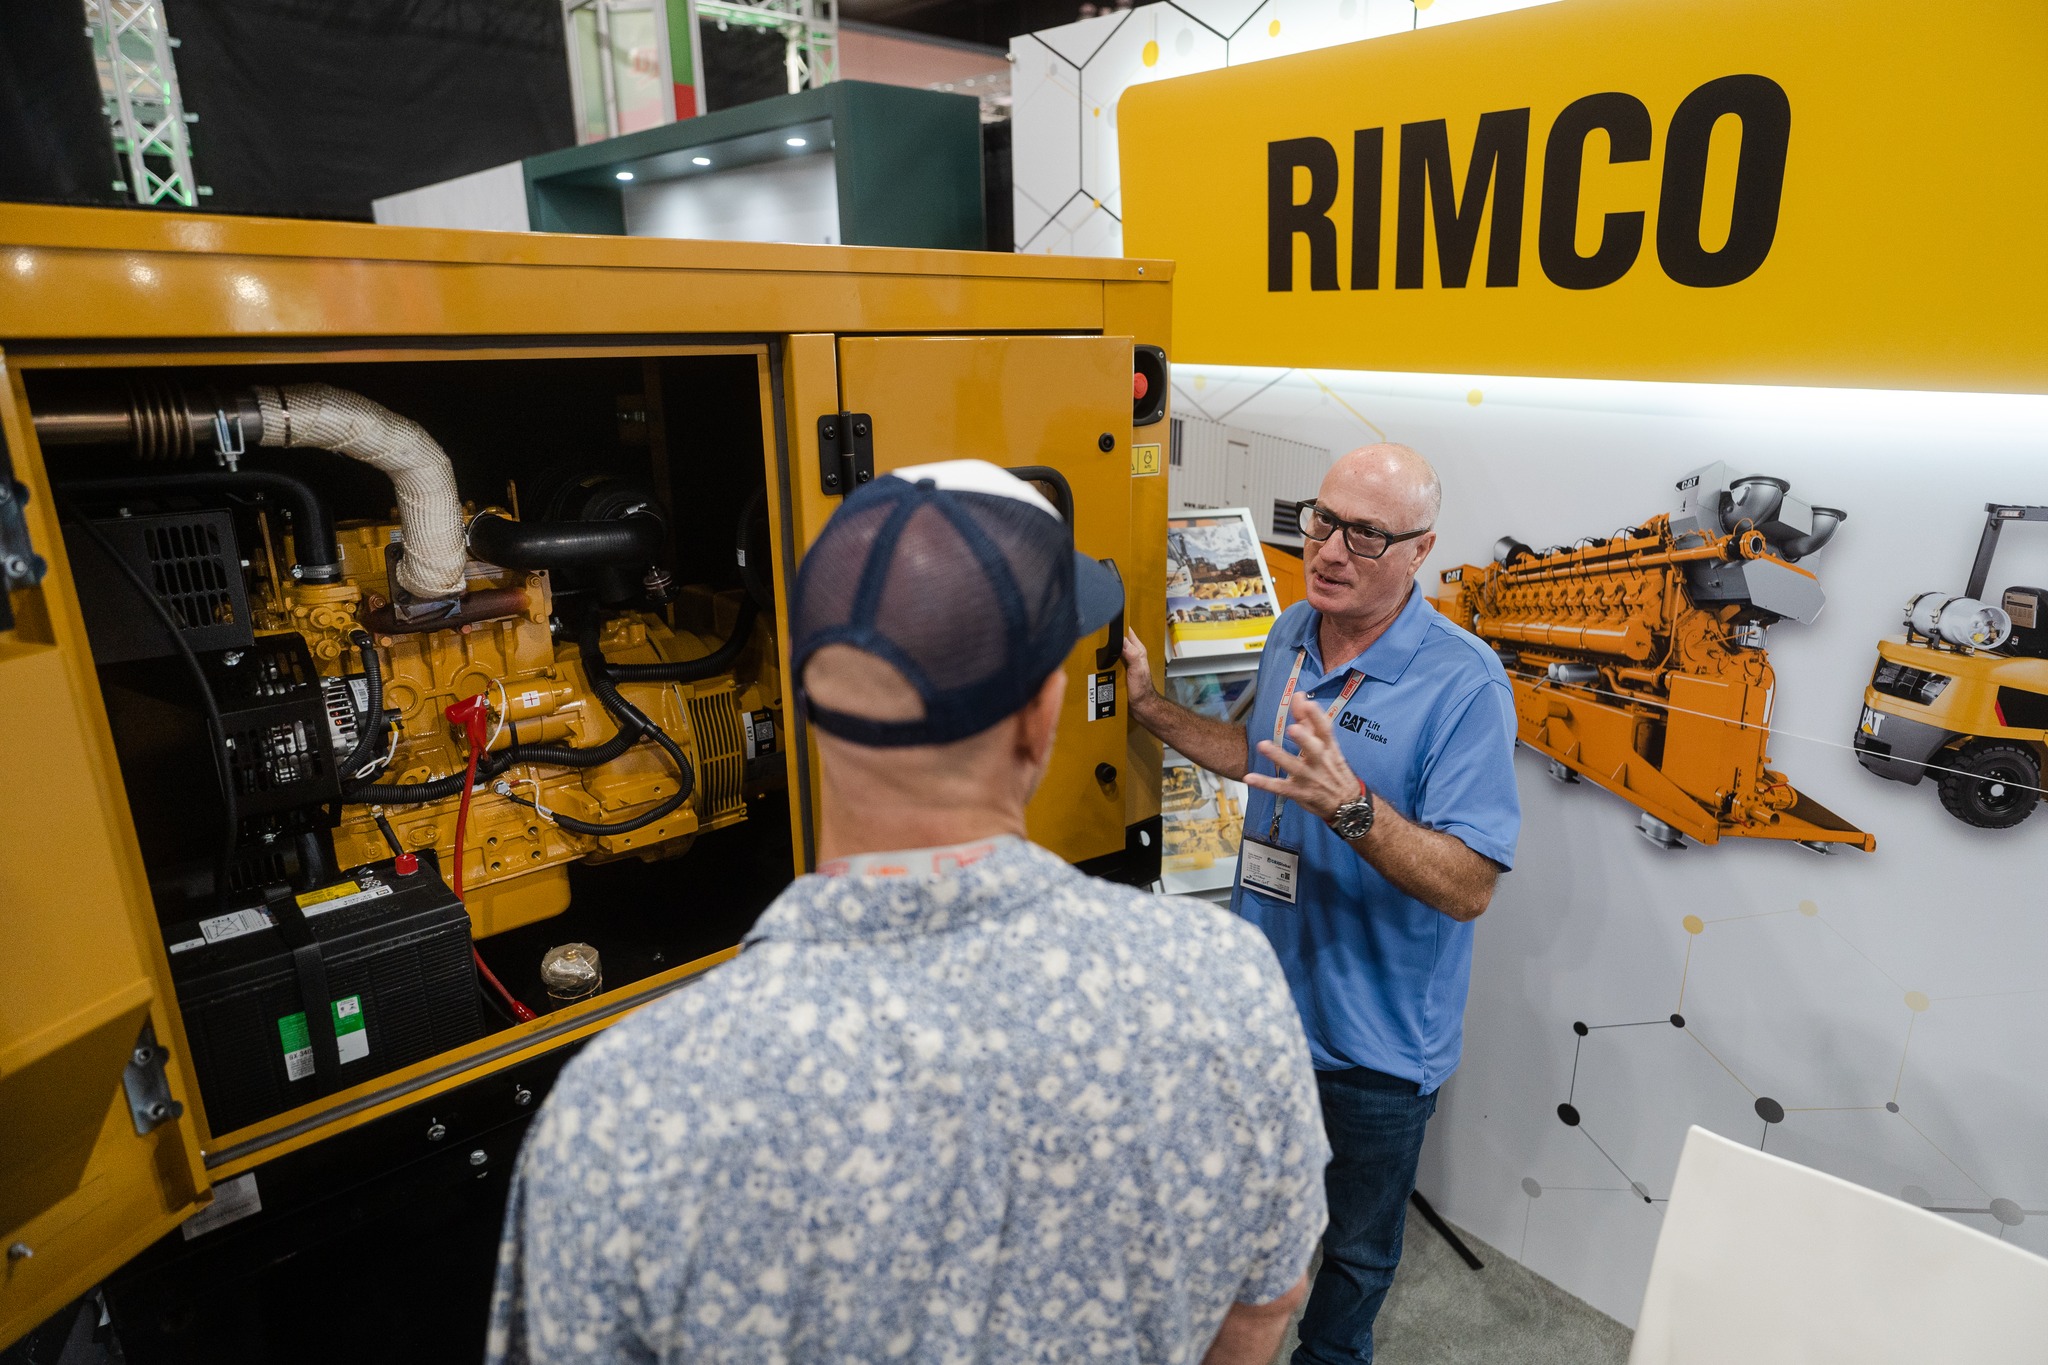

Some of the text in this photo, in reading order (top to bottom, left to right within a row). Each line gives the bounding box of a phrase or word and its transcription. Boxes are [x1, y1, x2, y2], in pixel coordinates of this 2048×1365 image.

[1267, 73, 1792, 293] RIMCO
[1682, 477, 1698, 490] CAT
[1446, 569, 1462, 583] CAT
[1339, 711, 1368, 734] CAT
[1367, 719, 1381, 732] Lift
[1364, 728, 1388, 745] Trucks
